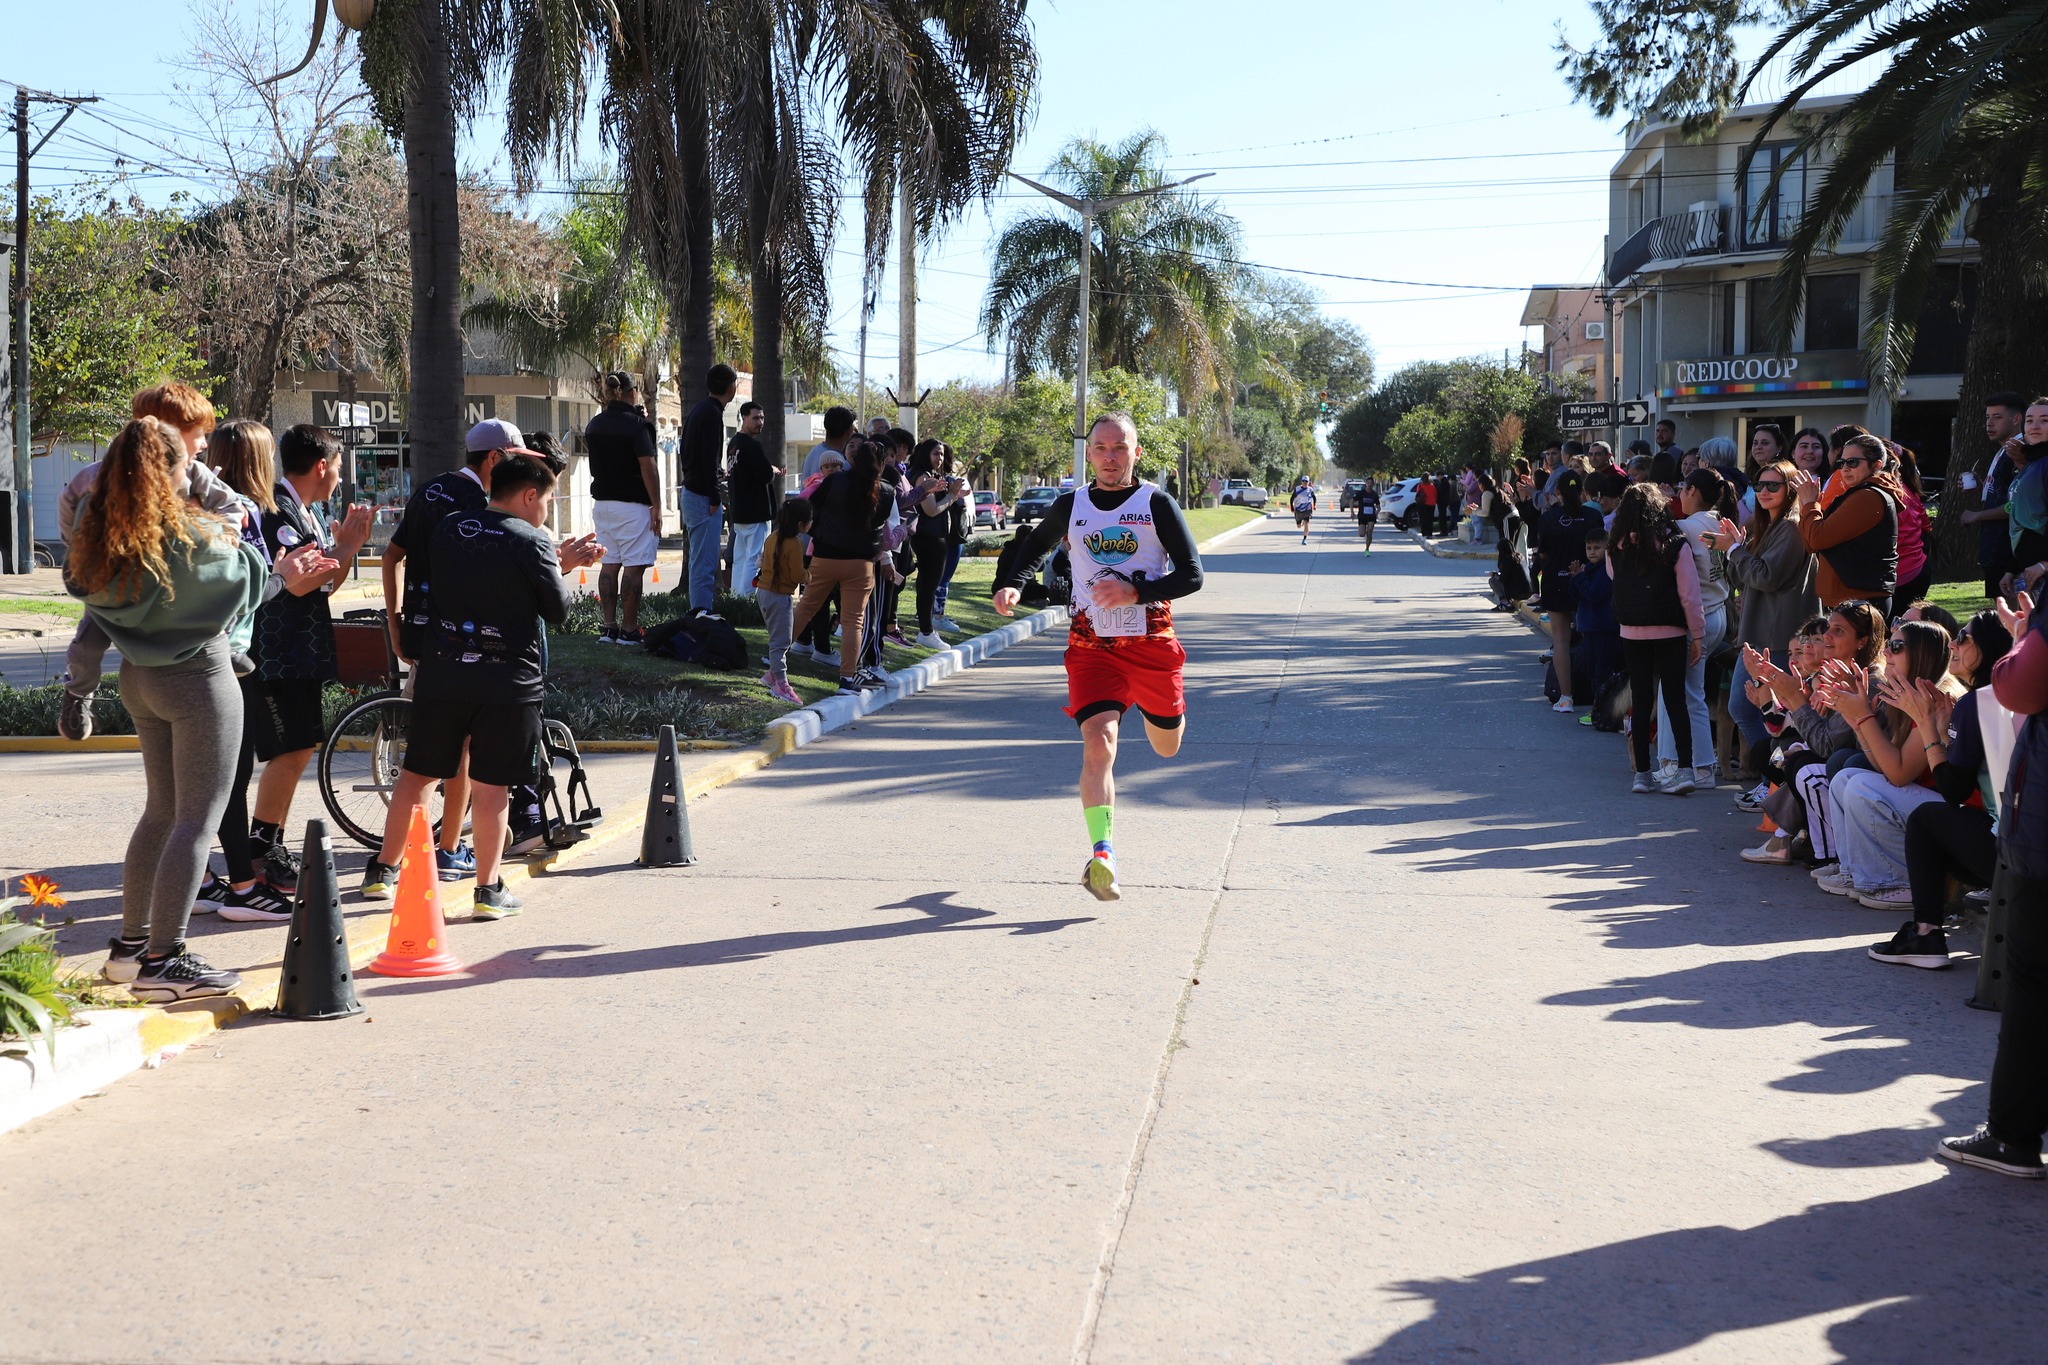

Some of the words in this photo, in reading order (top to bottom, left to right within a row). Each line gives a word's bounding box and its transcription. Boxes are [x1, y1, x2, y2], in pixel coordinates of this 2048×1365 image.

[1677, 358, 1798, 383] CREDICOOP
[1570, 406, 1605, 415] Maipú
[1567, 419, 1584, 427] 2200
[1119, 513, 1151, 522] ARIAS
[457, 523, 483, 532] NISSAN
[1097, 606, 1137, 629] 012
